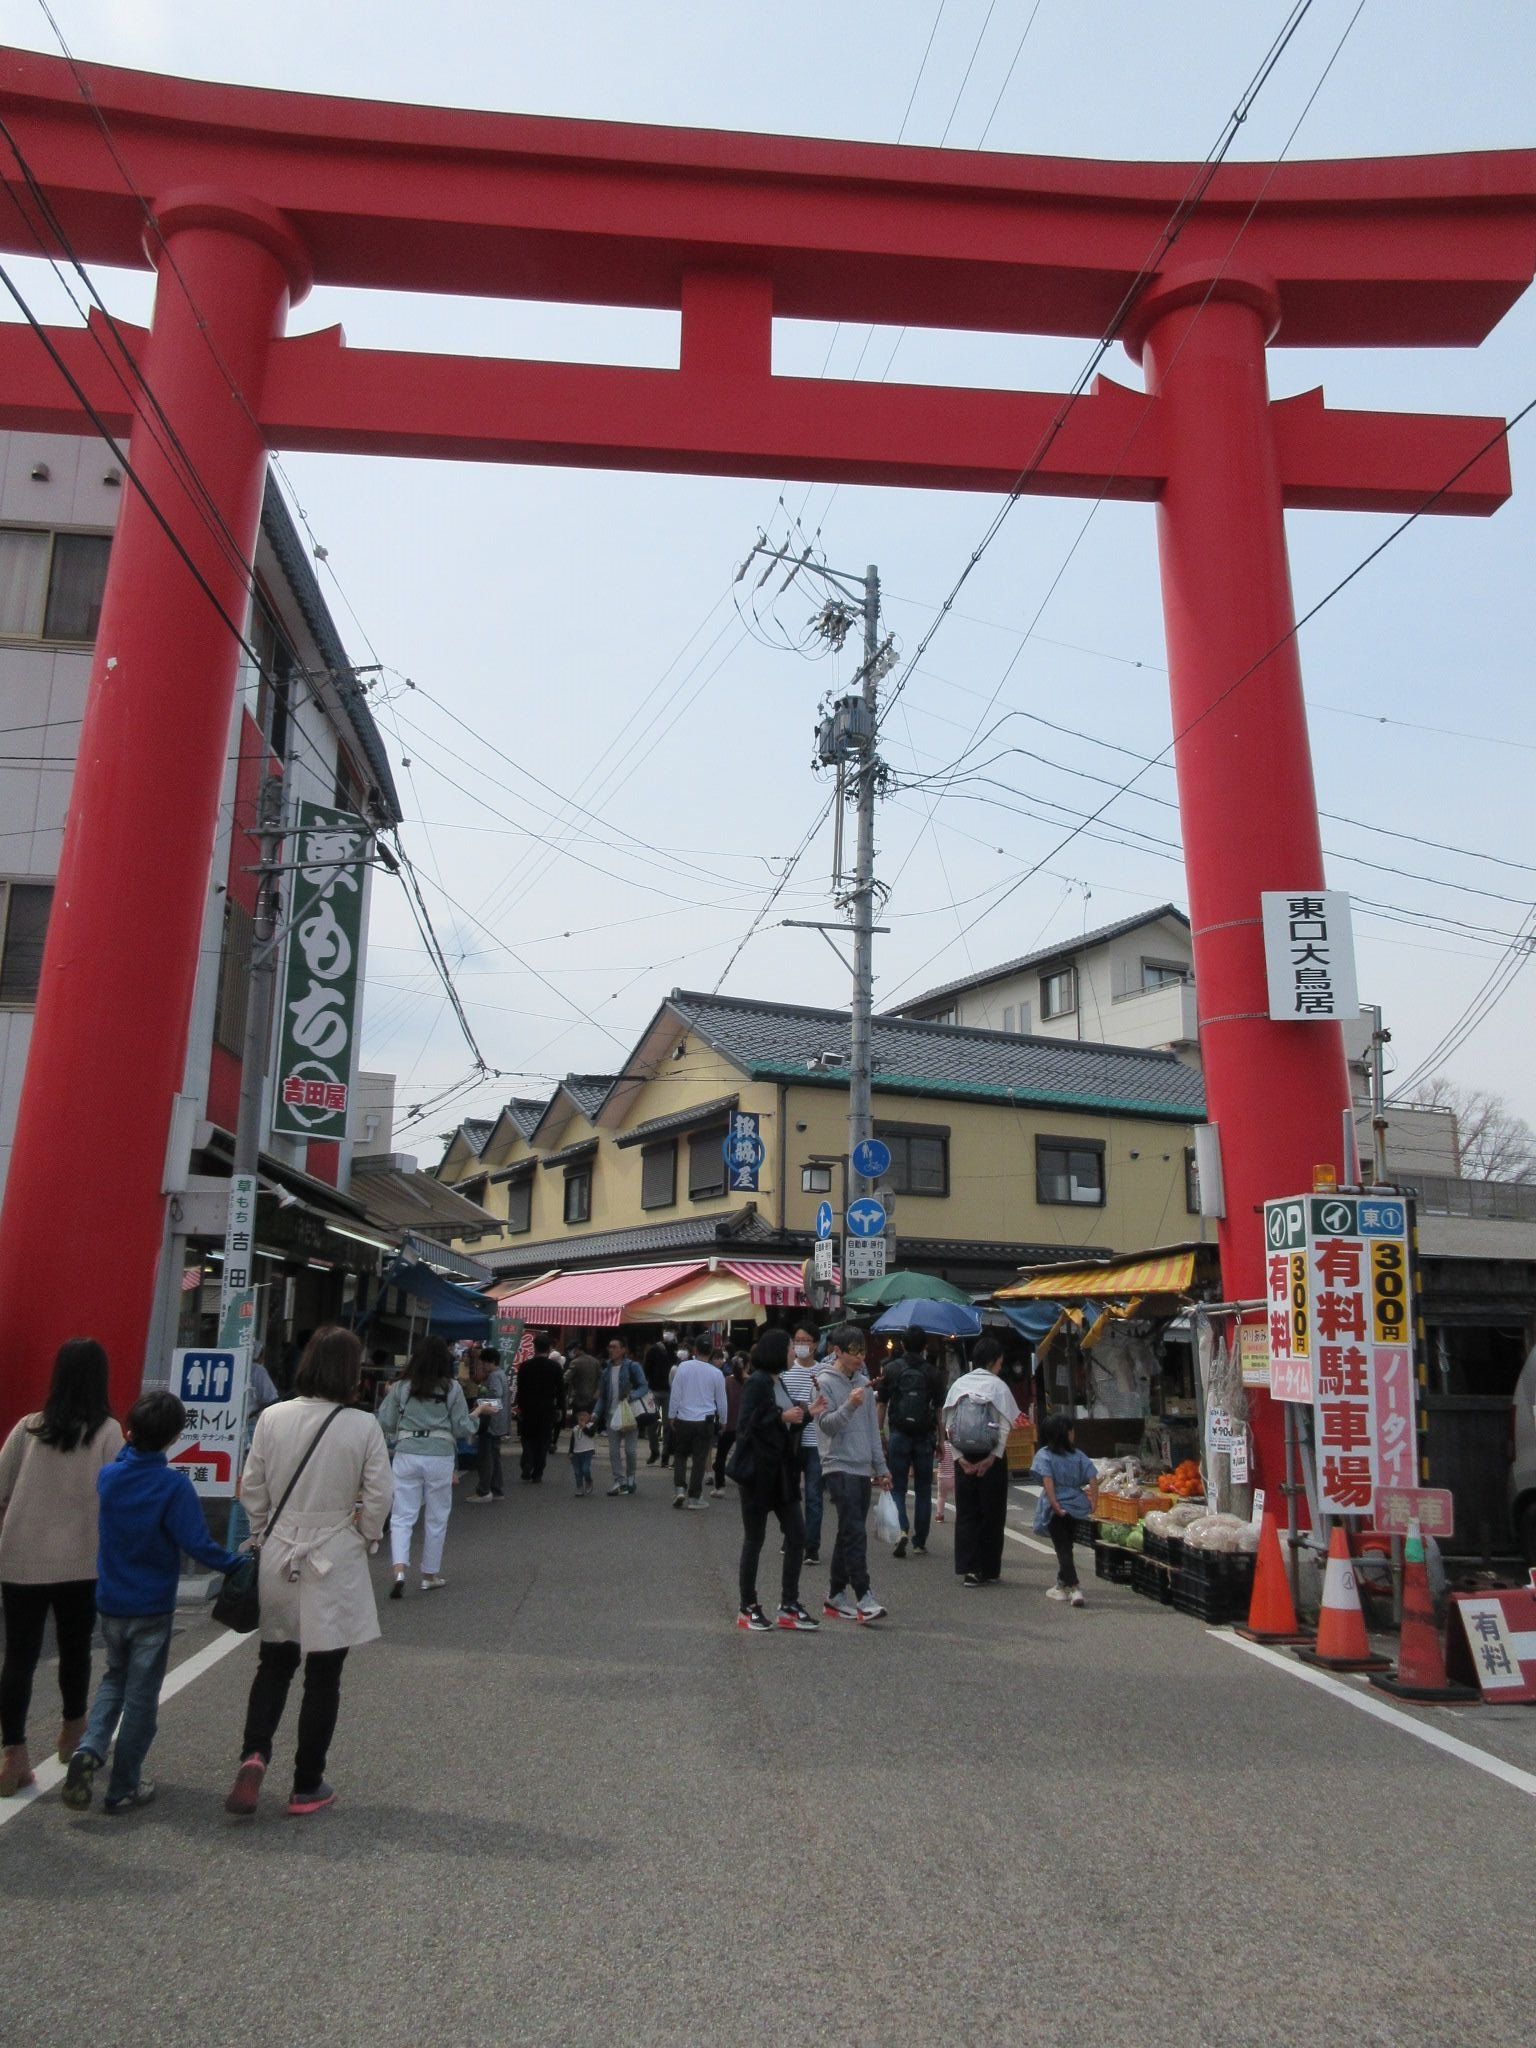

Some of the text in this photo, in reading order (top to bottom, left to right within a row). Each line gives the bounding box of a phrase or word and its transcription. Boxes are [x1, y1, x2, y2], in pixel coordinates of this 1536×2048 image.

[1286, 897, 1335, 1014] 東口大鳥居
[284, 1076, 346, 1111] 吉田屋
[235, 1179, 252, 1224] 草もち
[1268, 1253, 1292, 1358] 有料
[1292, 1256, 1307, 1351] 300円
[1374, 1243, 1405, 1340] 300円
[1273, 1364, 1311, 1395] ノータイム
[1315, 1238, 1372, 1508] 有料駐車場
[185, 1409, 237, 1430] 衆トイレ
[1471, 1612, 1513, 1675] 有料
